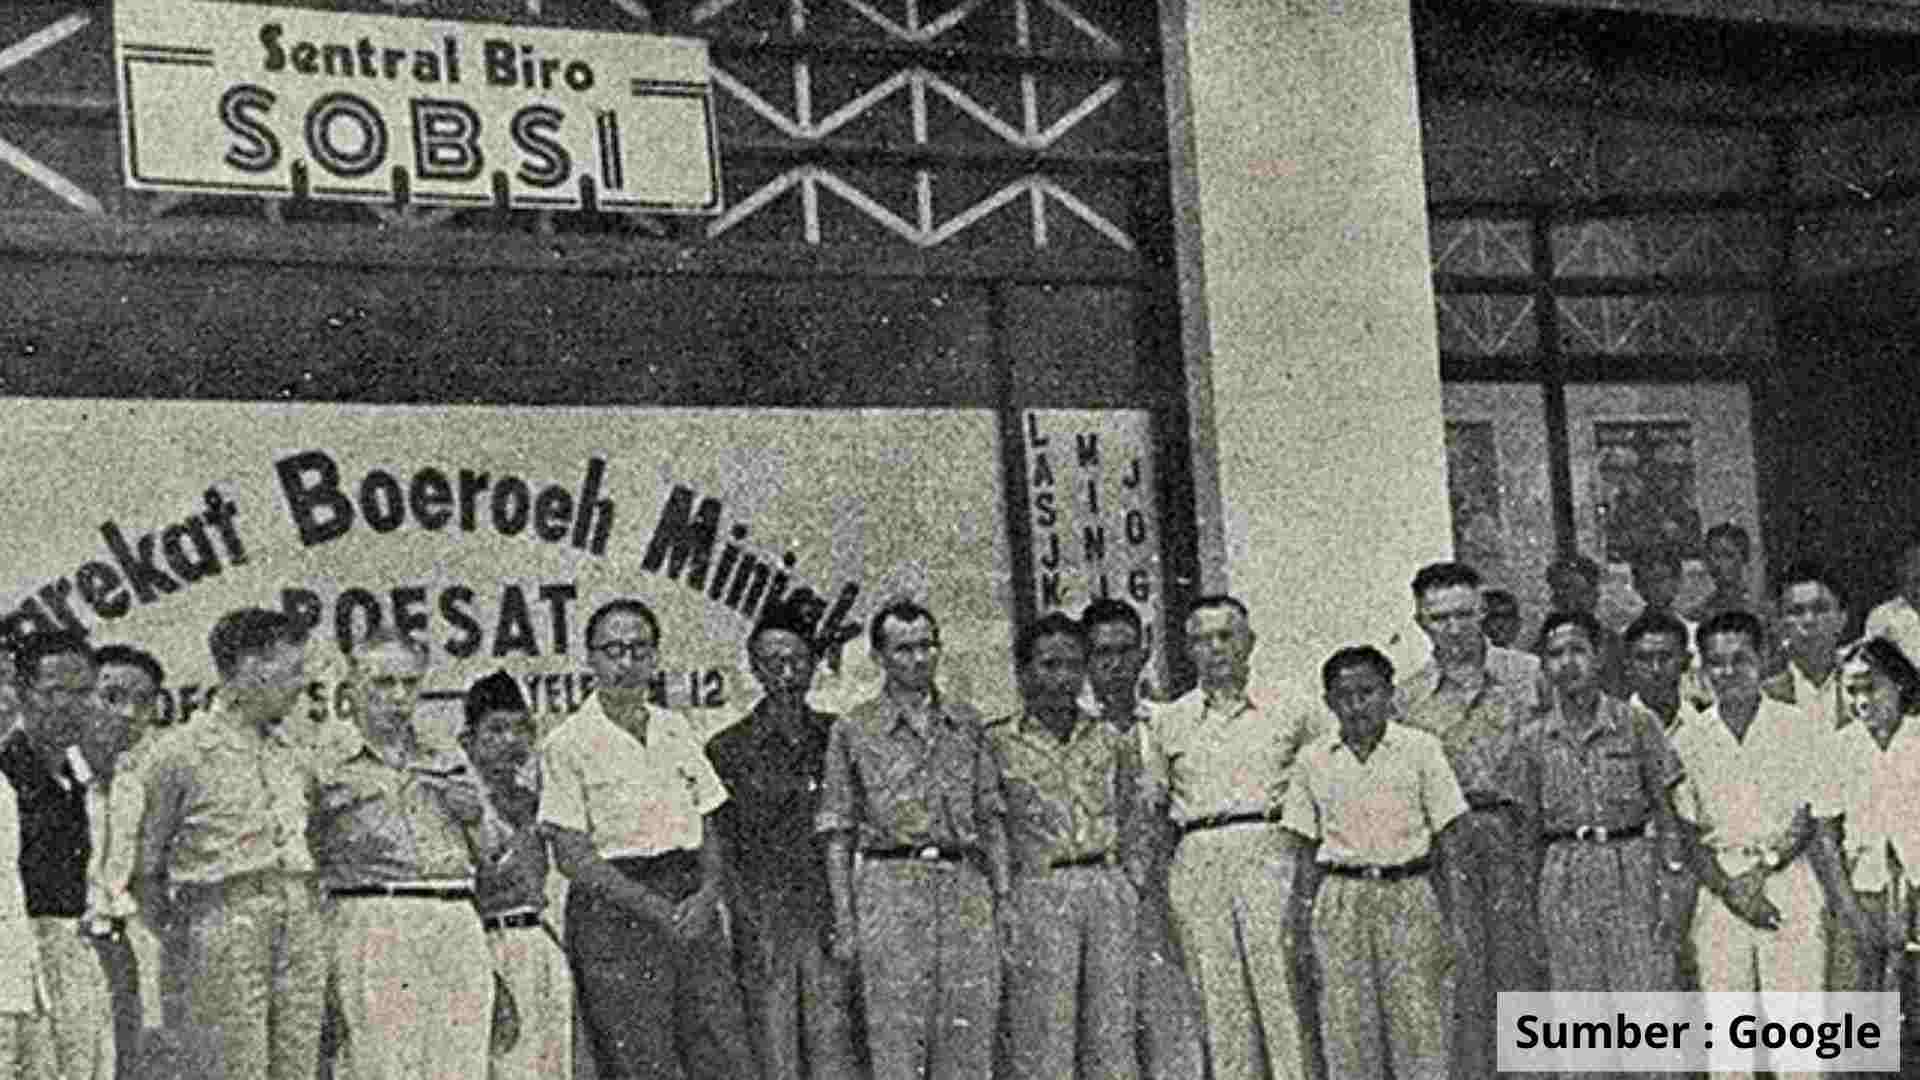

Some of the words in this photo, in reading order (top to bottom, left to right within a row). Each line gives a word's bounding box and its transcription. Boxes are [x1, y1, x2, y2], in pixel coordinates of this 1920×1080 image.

[258, 23, 461, 84] Sentral
[483, 39, 595, 91] Biro
[275, 450, 614, 556] Boeroeh
[691, 670, 725, 707] 12
